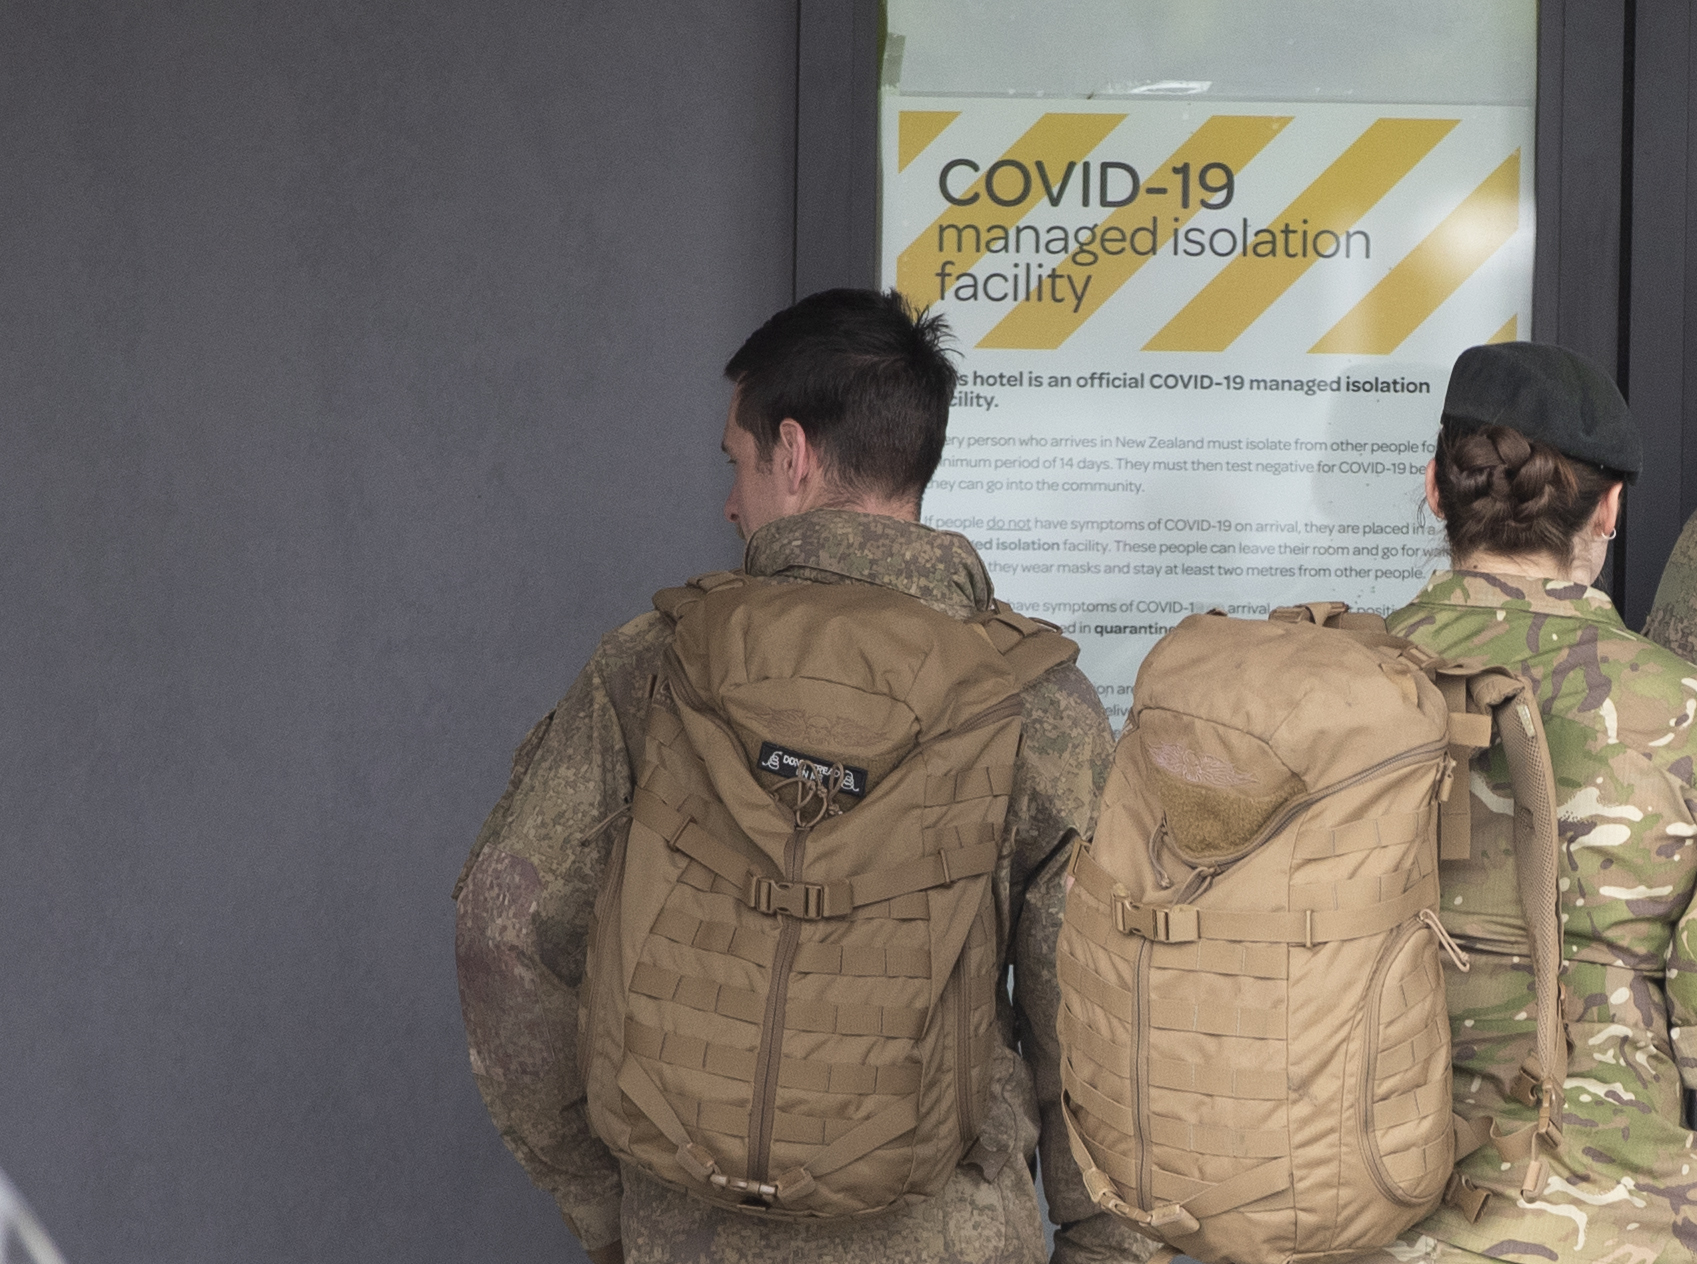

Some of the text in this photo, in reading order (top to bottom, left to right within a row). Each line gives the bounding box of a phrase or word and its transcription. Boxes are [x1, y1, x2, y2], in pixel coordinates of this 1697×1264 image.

[938, 158, 1236, 210] COVID-19
[937, 216, 1372, 266] managed isolation
[935, 262, 1093, 313] facility
[972, 371, 1023, 387] hotel
[1028, 371, 1043, 387] is
[1048, 376, 1071, 388] an
[1076, 372, 1144, 389] official
[1149, 374, 1245, 390] COVID-19
[1249, 376, 1341, 396] managed
[1346, 376, 1430, 393] isolation
[950, 391, 999, 411] cility.
[945, 434, 1436, 455] ery person who arrives in New Zealand must isolate from other people fo
[994, 455, 1040, 471] period
[1042, 456, 1058, 469] of
[1060, 457, 1074, 469] 14
[1077, 457, 1113, 472] days.
[1116, 458, 1150, 472] They
[1153, 460, 1188, 471] must
[1191, 459, 1223, 471] then
[1225, 461, 1252, 472] test
[1255, 461, 1314, 476] negative
[1317, 460, 1337, 474] for
[1338, 461, 1407, 476] COVID-19
[958, 480, 984, 490] can
[985, 480, 1004, 493] go
[1006, 478, 1034, 491] into
[1035, 479, 1059, 491] the
[1061, 480, 1145, 495] community.
[935, 516, 984, 530] people
[986, 516, 1005, 531] do
[1008, 517, 1032, 532] not
[1034, 517, 1068, 530] have
[1070, 519, 1145, 533] symptoms
[1147, 518, 1163, 531] of
[1164, 519, 1232, 532] COVID-19
[1234, 522, 1253, 532] on
[1255, 521, 1301, 534] arrival,
[1304, 521, 1335, 536] they
[1337, 524, 1360, 534] are
[1362, 522, 1410, 536] placed
[1412, 521, 1425, 535] in
[1427, 526, 1436, 535] a
[996, 538, 1060, 551] isolation
[1062, 539, 1111, 555] facility.
[1114, 540, 1157, 553] These
[1159, 541, 1208, 556] people
[1210, 544, 1236, 554] can
[1238, 542, 1275, 555] leave
[1278, 543, 1310, 555] their
[1312, 545, 1350, 556] room
[1352, 544, 1379, 556] and
[1381, 547, 1399, 560] go
[1400, 544, 1420, 557] for
[987, 561, 1426, 581] they wear masks and stay at least two metres from other people.
[1043, 602, 1117, 615] symptoms
[1119, 600, 1134, 613] of
[1227, 602, 1271, 615] arrival
[1079, 621, 1092, 634] in
